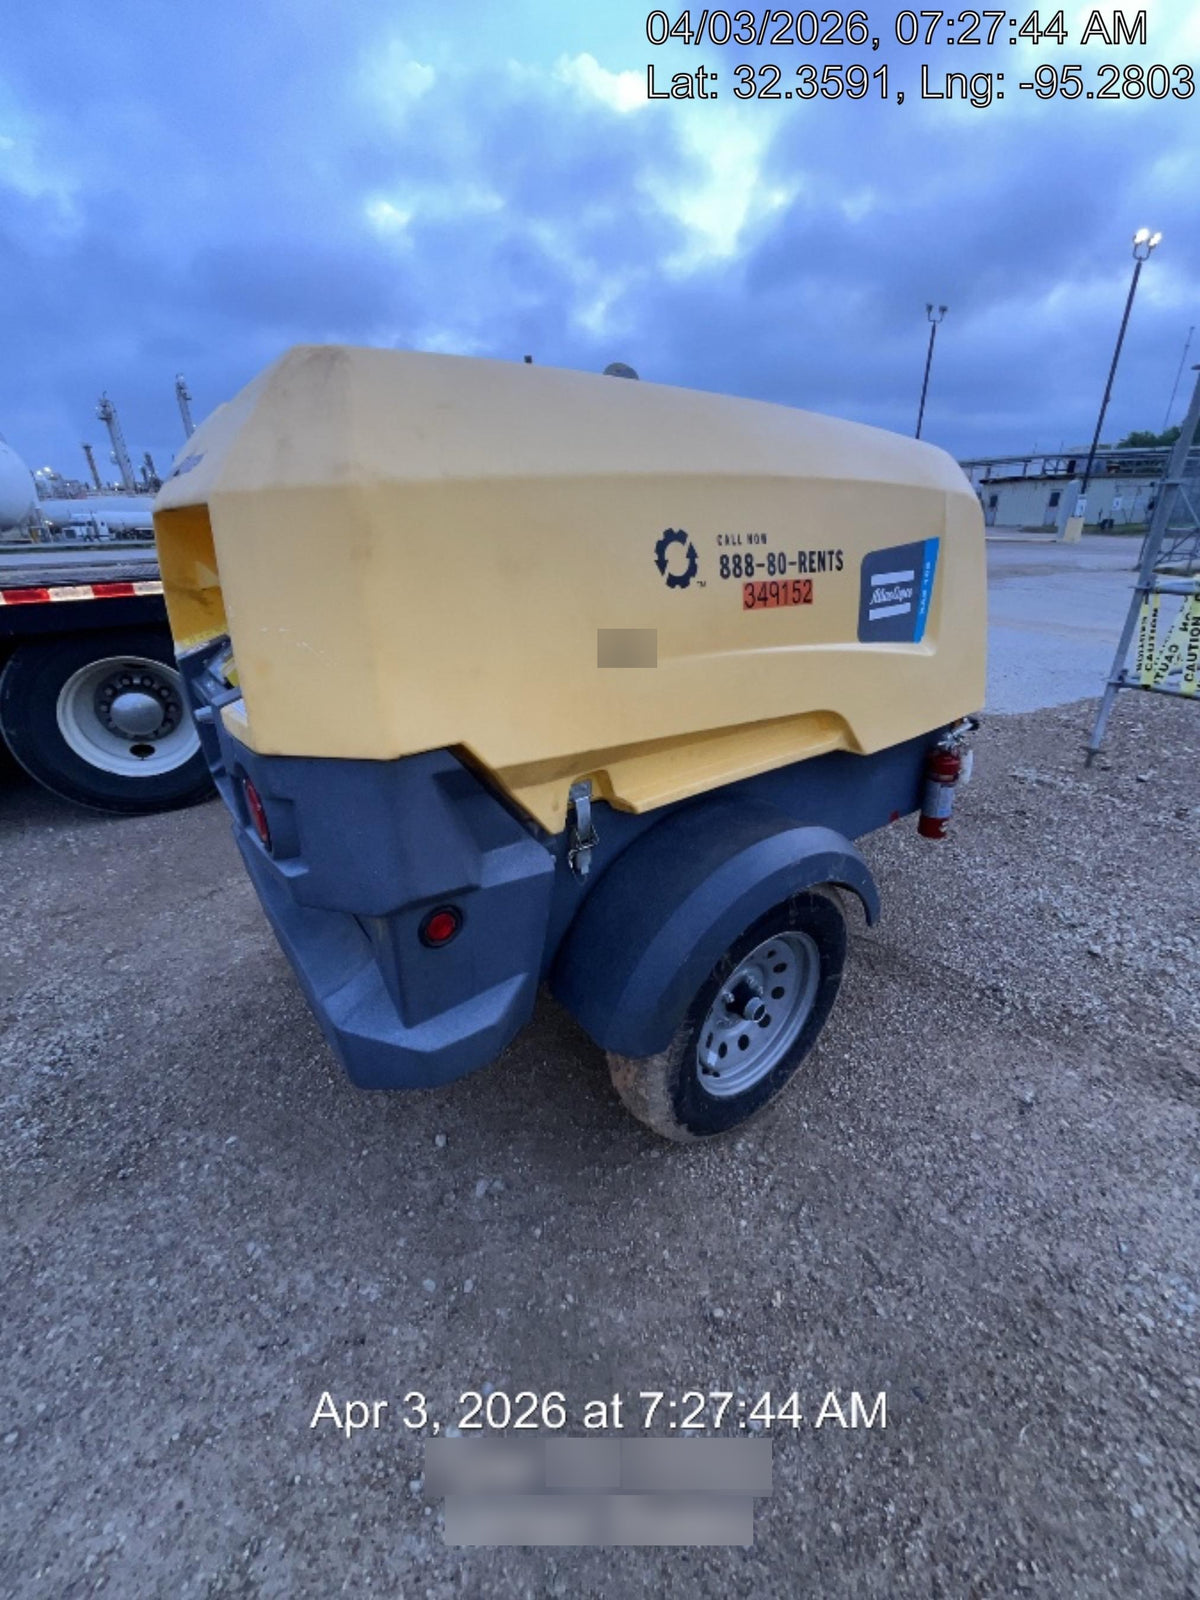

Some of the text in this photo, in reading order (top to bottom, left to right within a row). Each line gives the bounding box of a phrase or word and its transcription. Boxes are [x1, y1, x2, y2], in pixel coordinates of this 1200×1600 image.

[717, 533, 767, 546] CALL NOW
[720, 549, 844, 579] 888-80-RENTS
[744, 579, 813, 609] 349152
[1145, 608, 1159, 671] CAUTION
[1184, 616, 1200, 682] CAUTION
